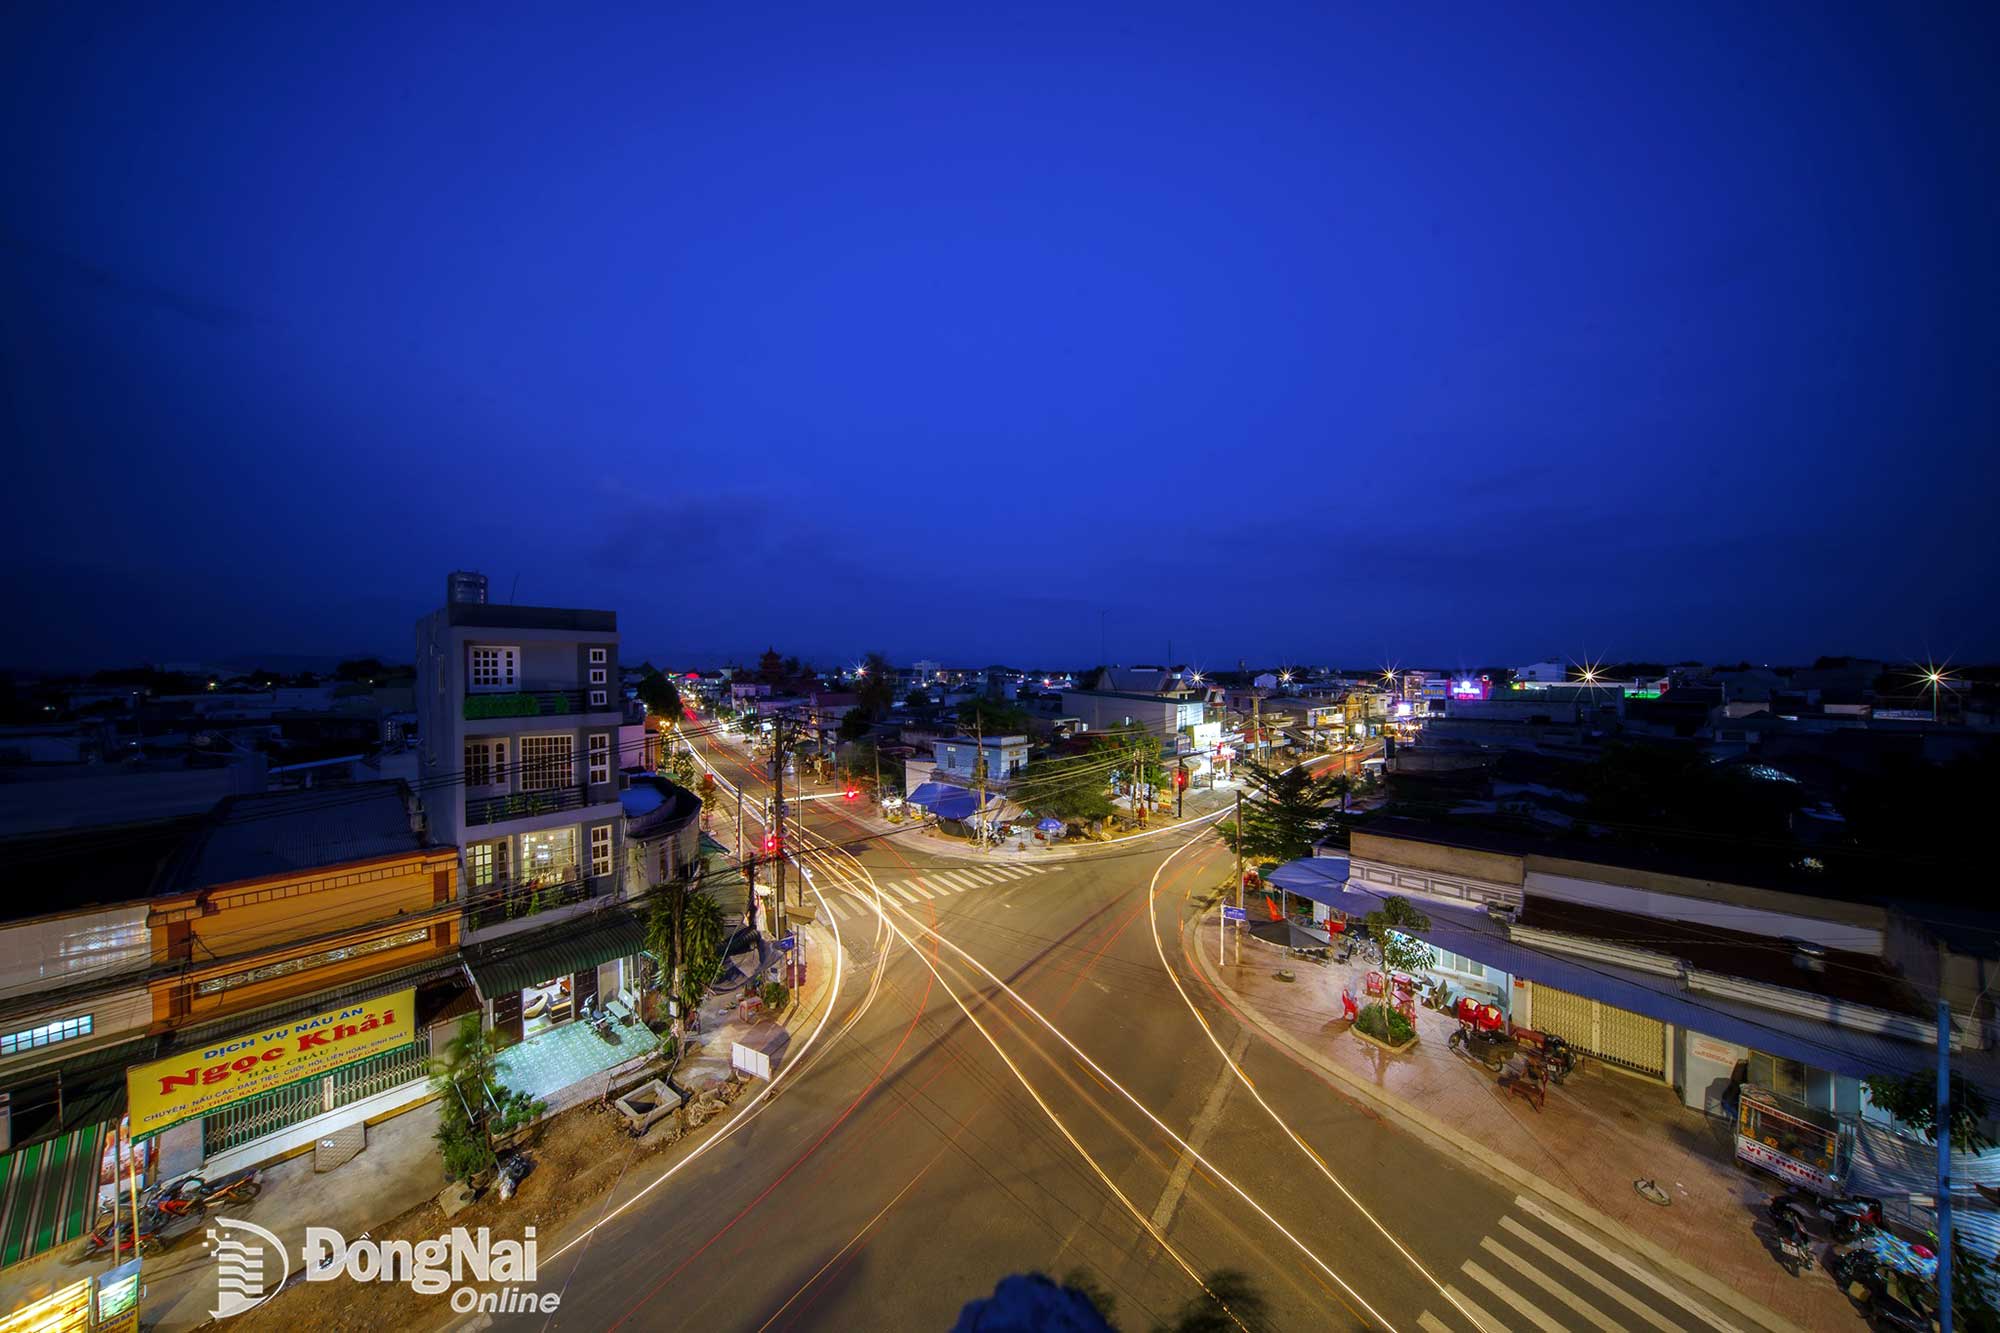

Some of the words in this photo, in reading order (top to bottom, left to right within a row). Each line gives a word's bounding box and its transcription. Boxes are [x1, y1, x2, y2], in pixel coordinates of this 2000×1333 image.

[158, 1047, 286, 1096] Ngọc
[297, 1009, 396, 1052] Khải
[204, 1039, 255, 1059] DỊCH
[262, 1029, 289, 1041] VỤ
[295, 1014, 333, 1033] NẤU
